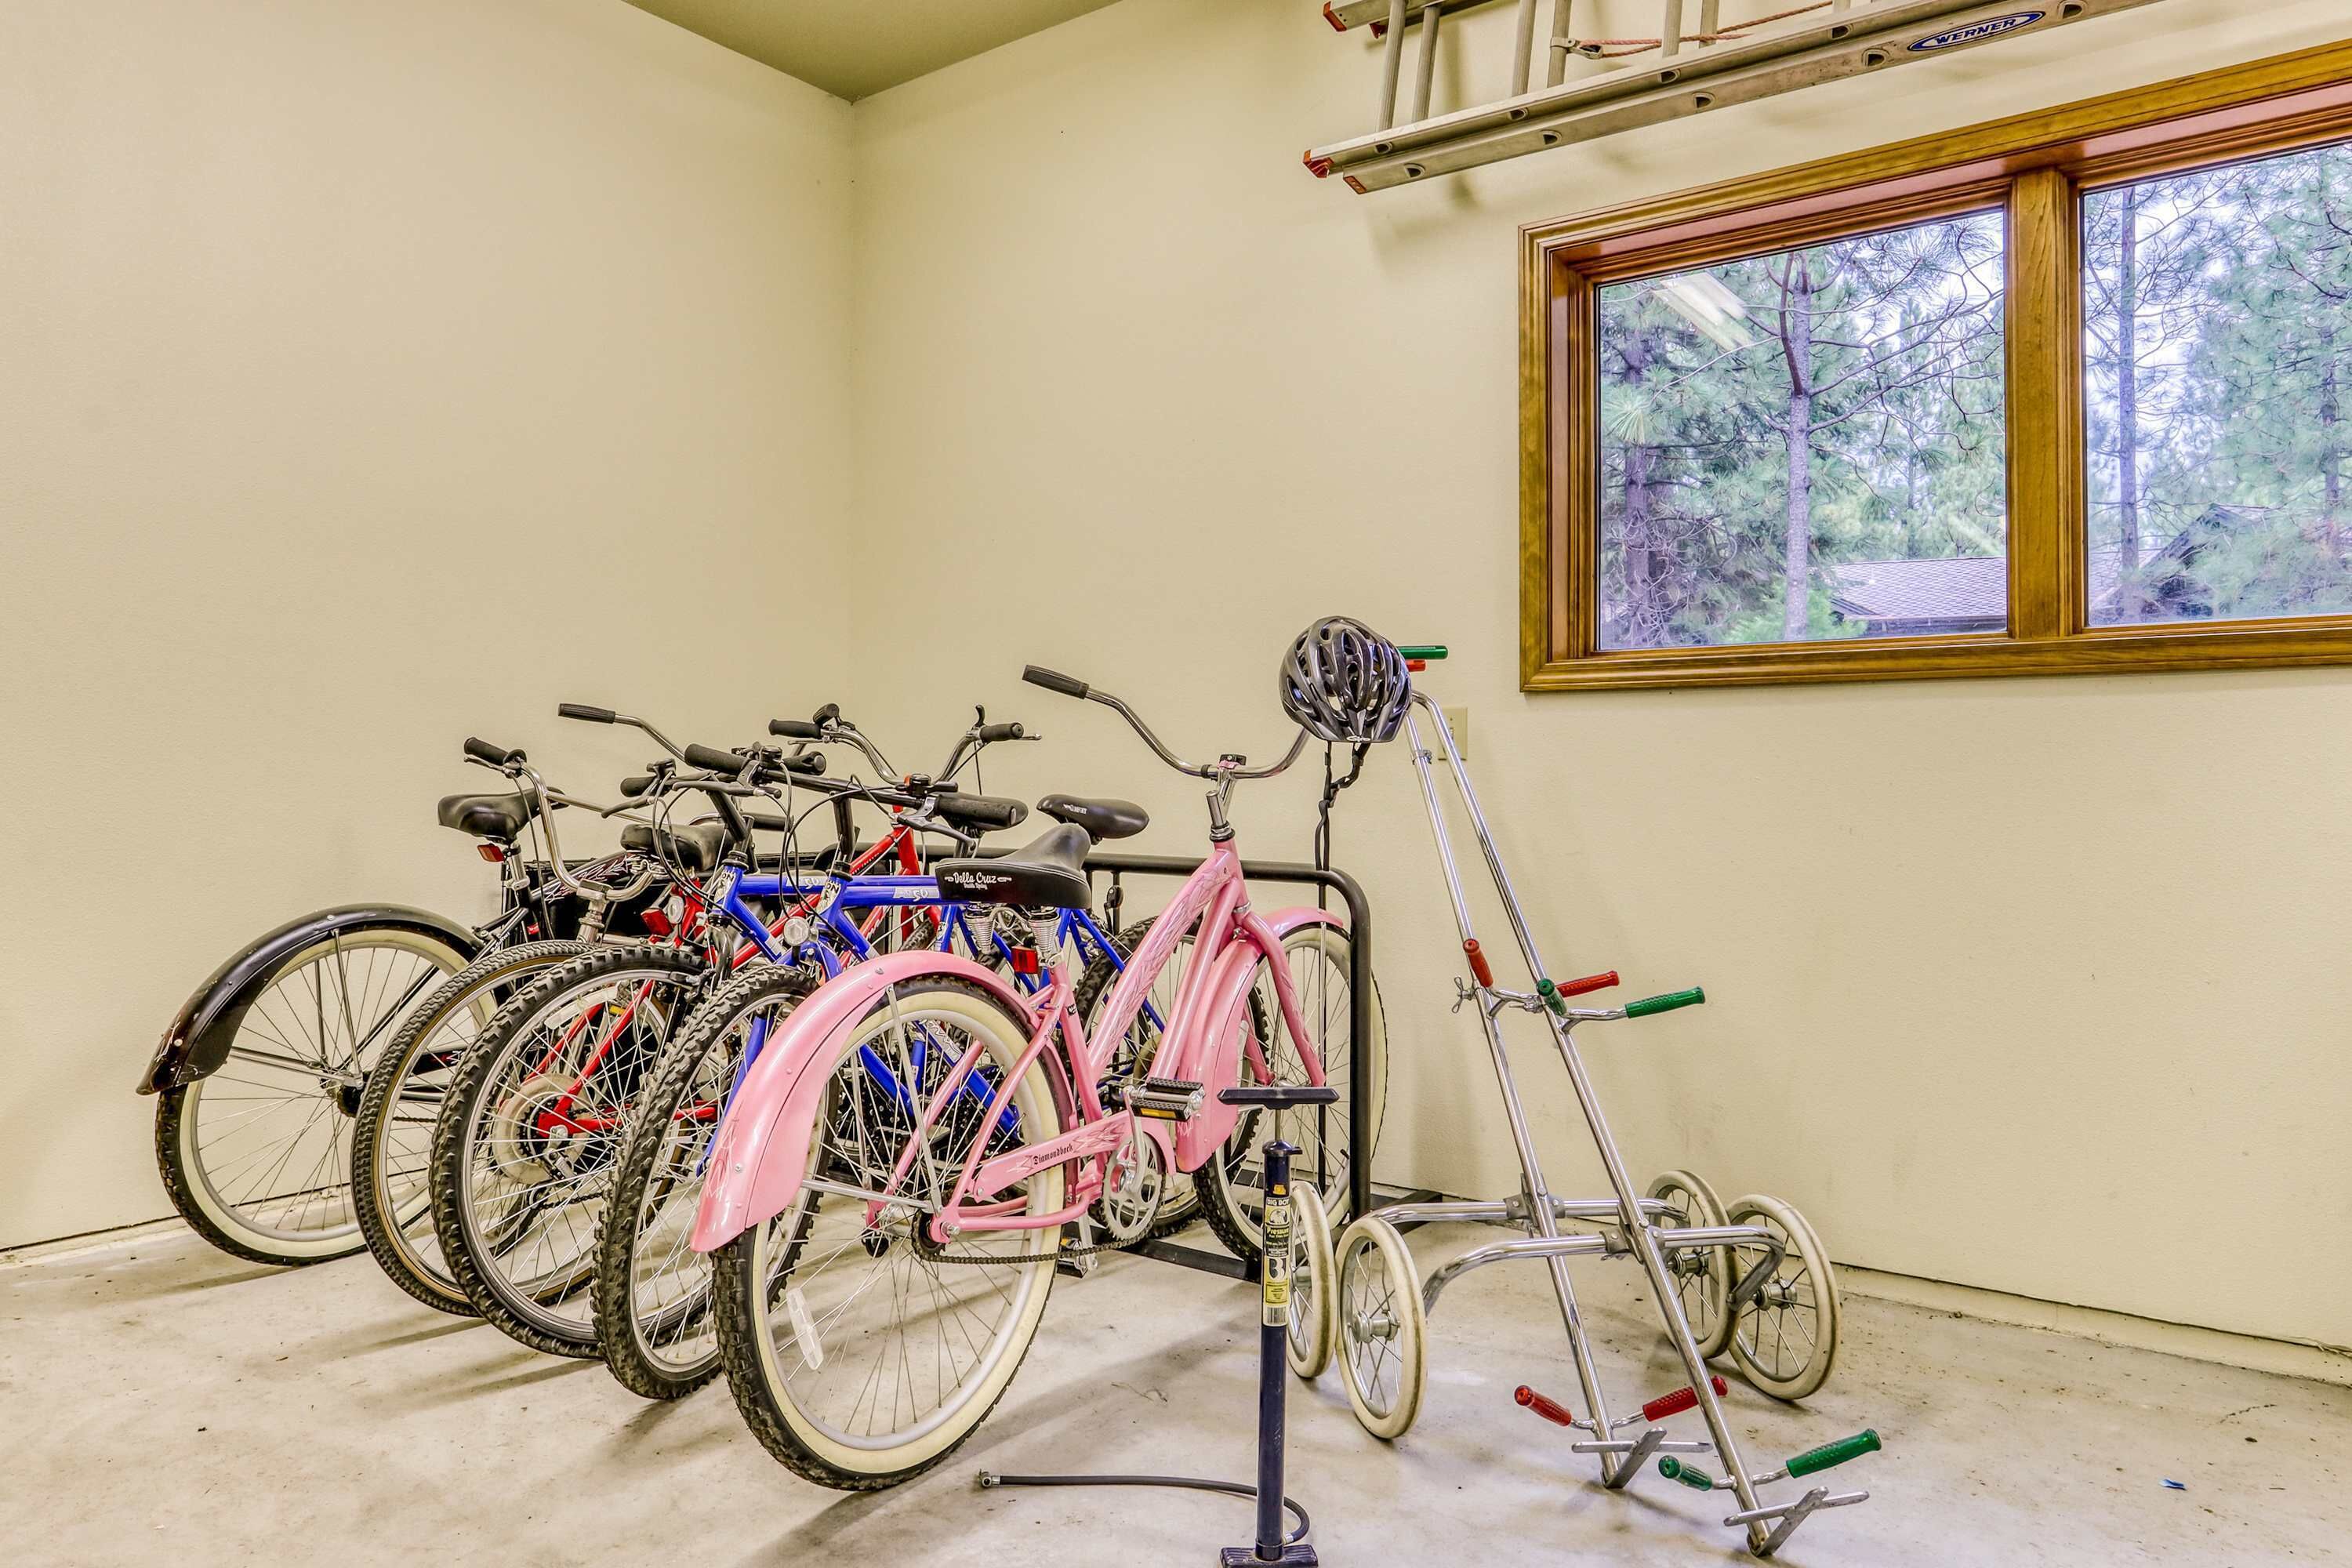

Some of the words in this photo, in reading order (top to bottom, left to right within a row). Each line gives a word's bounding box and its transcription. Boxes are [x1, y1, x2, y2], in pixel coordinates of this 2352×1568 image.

[1934, 19, 2017, 44] WERNER
[953, 872, 975, 884] Della
[976, 872, 997, 884] Cruz
[1033, 1143, 1073, 1165] Diamondback
